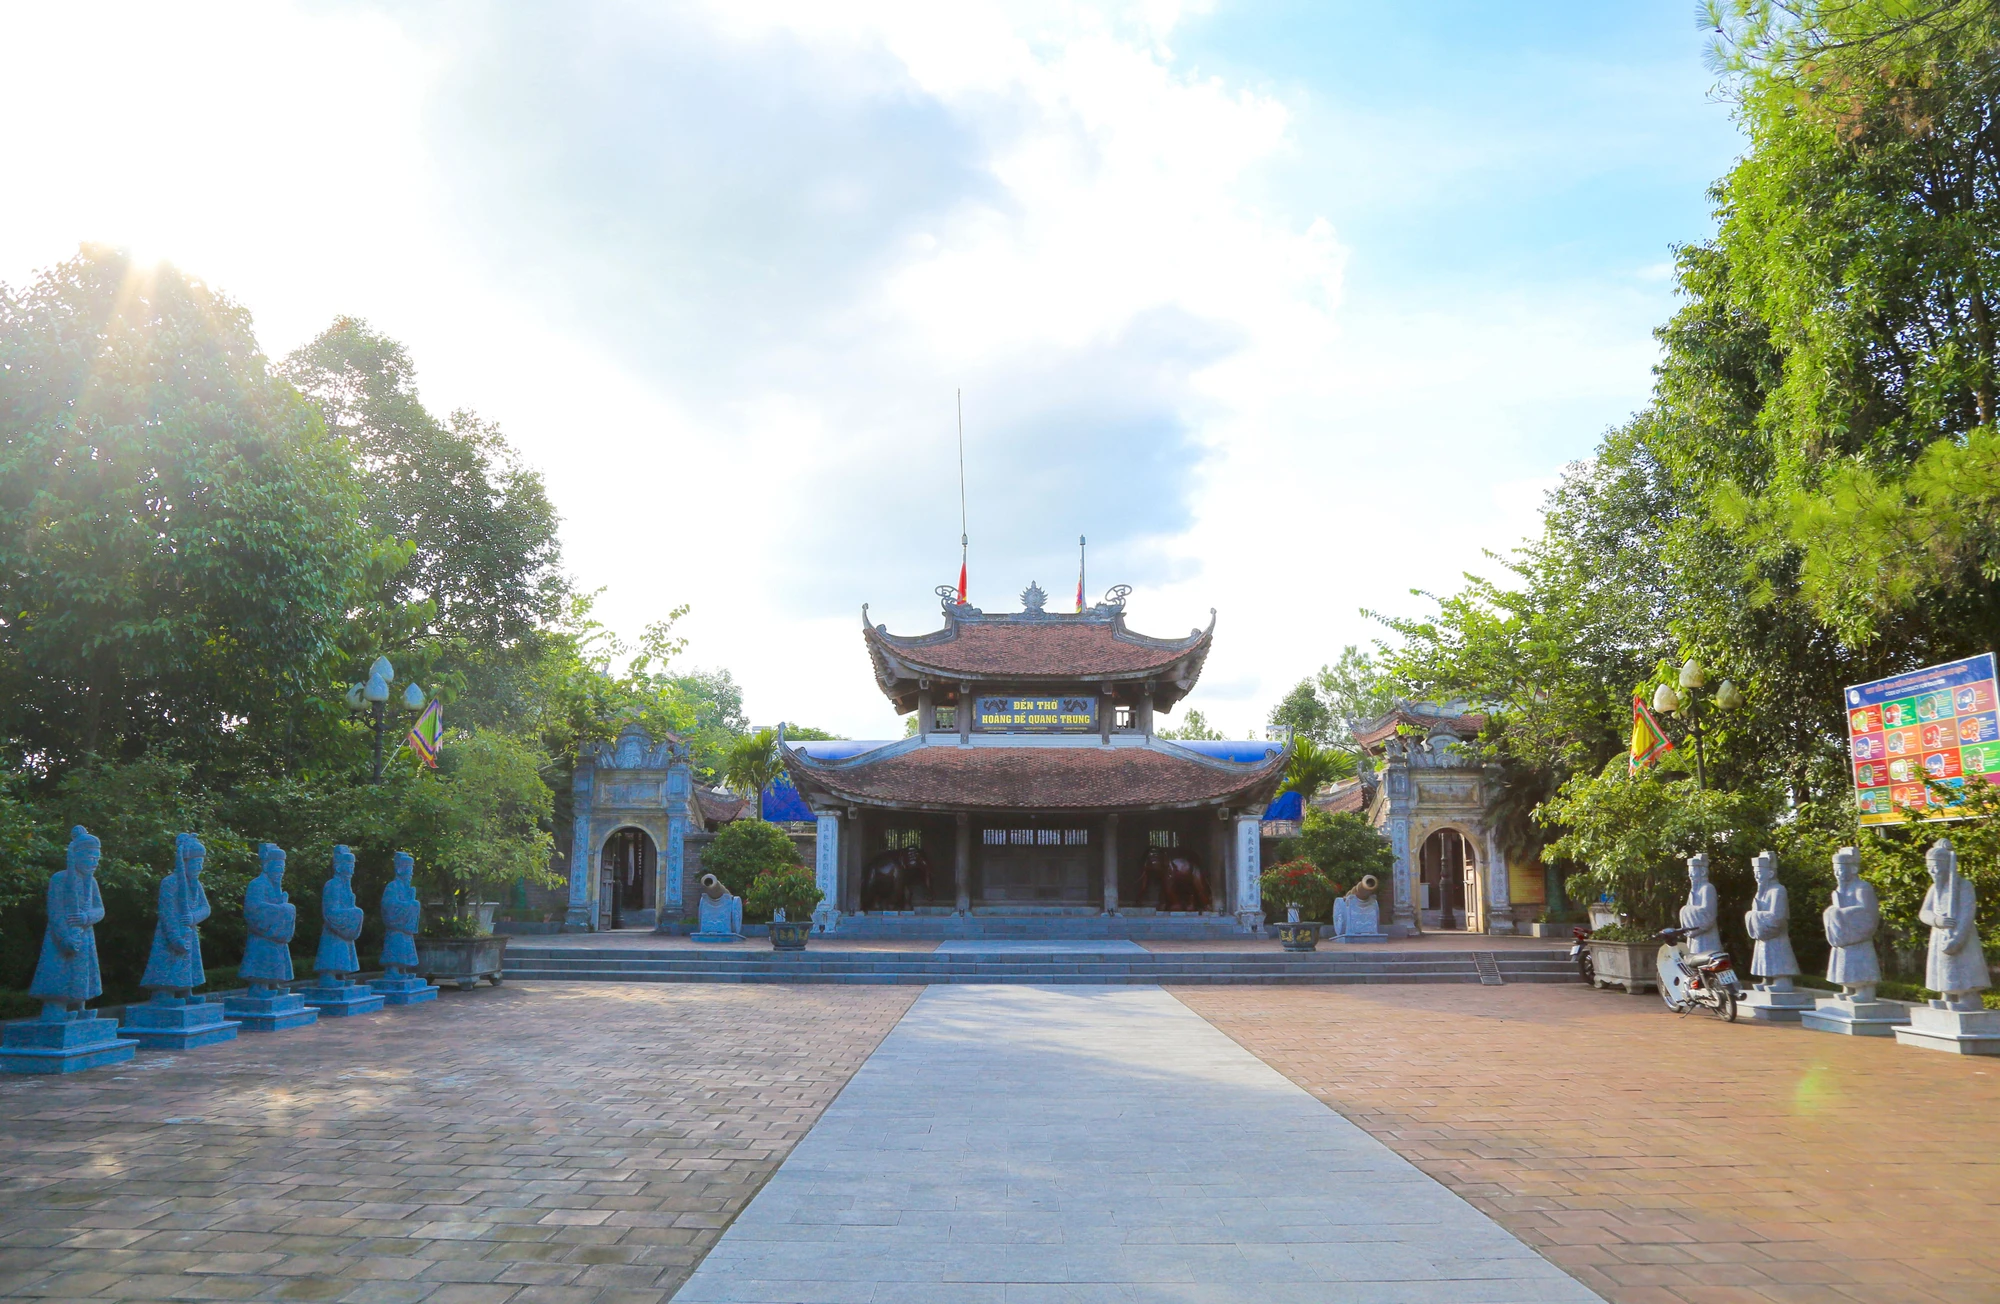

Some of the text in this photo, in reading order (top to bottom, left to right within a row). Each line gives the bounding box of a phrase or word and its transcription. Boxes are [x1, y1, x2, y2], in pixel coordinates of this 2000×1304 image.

[1037, 699, 1059, 710] THỜ
[982, 712, 1090, 725] HOÀNG ĐẾ QUANG TRUNG
